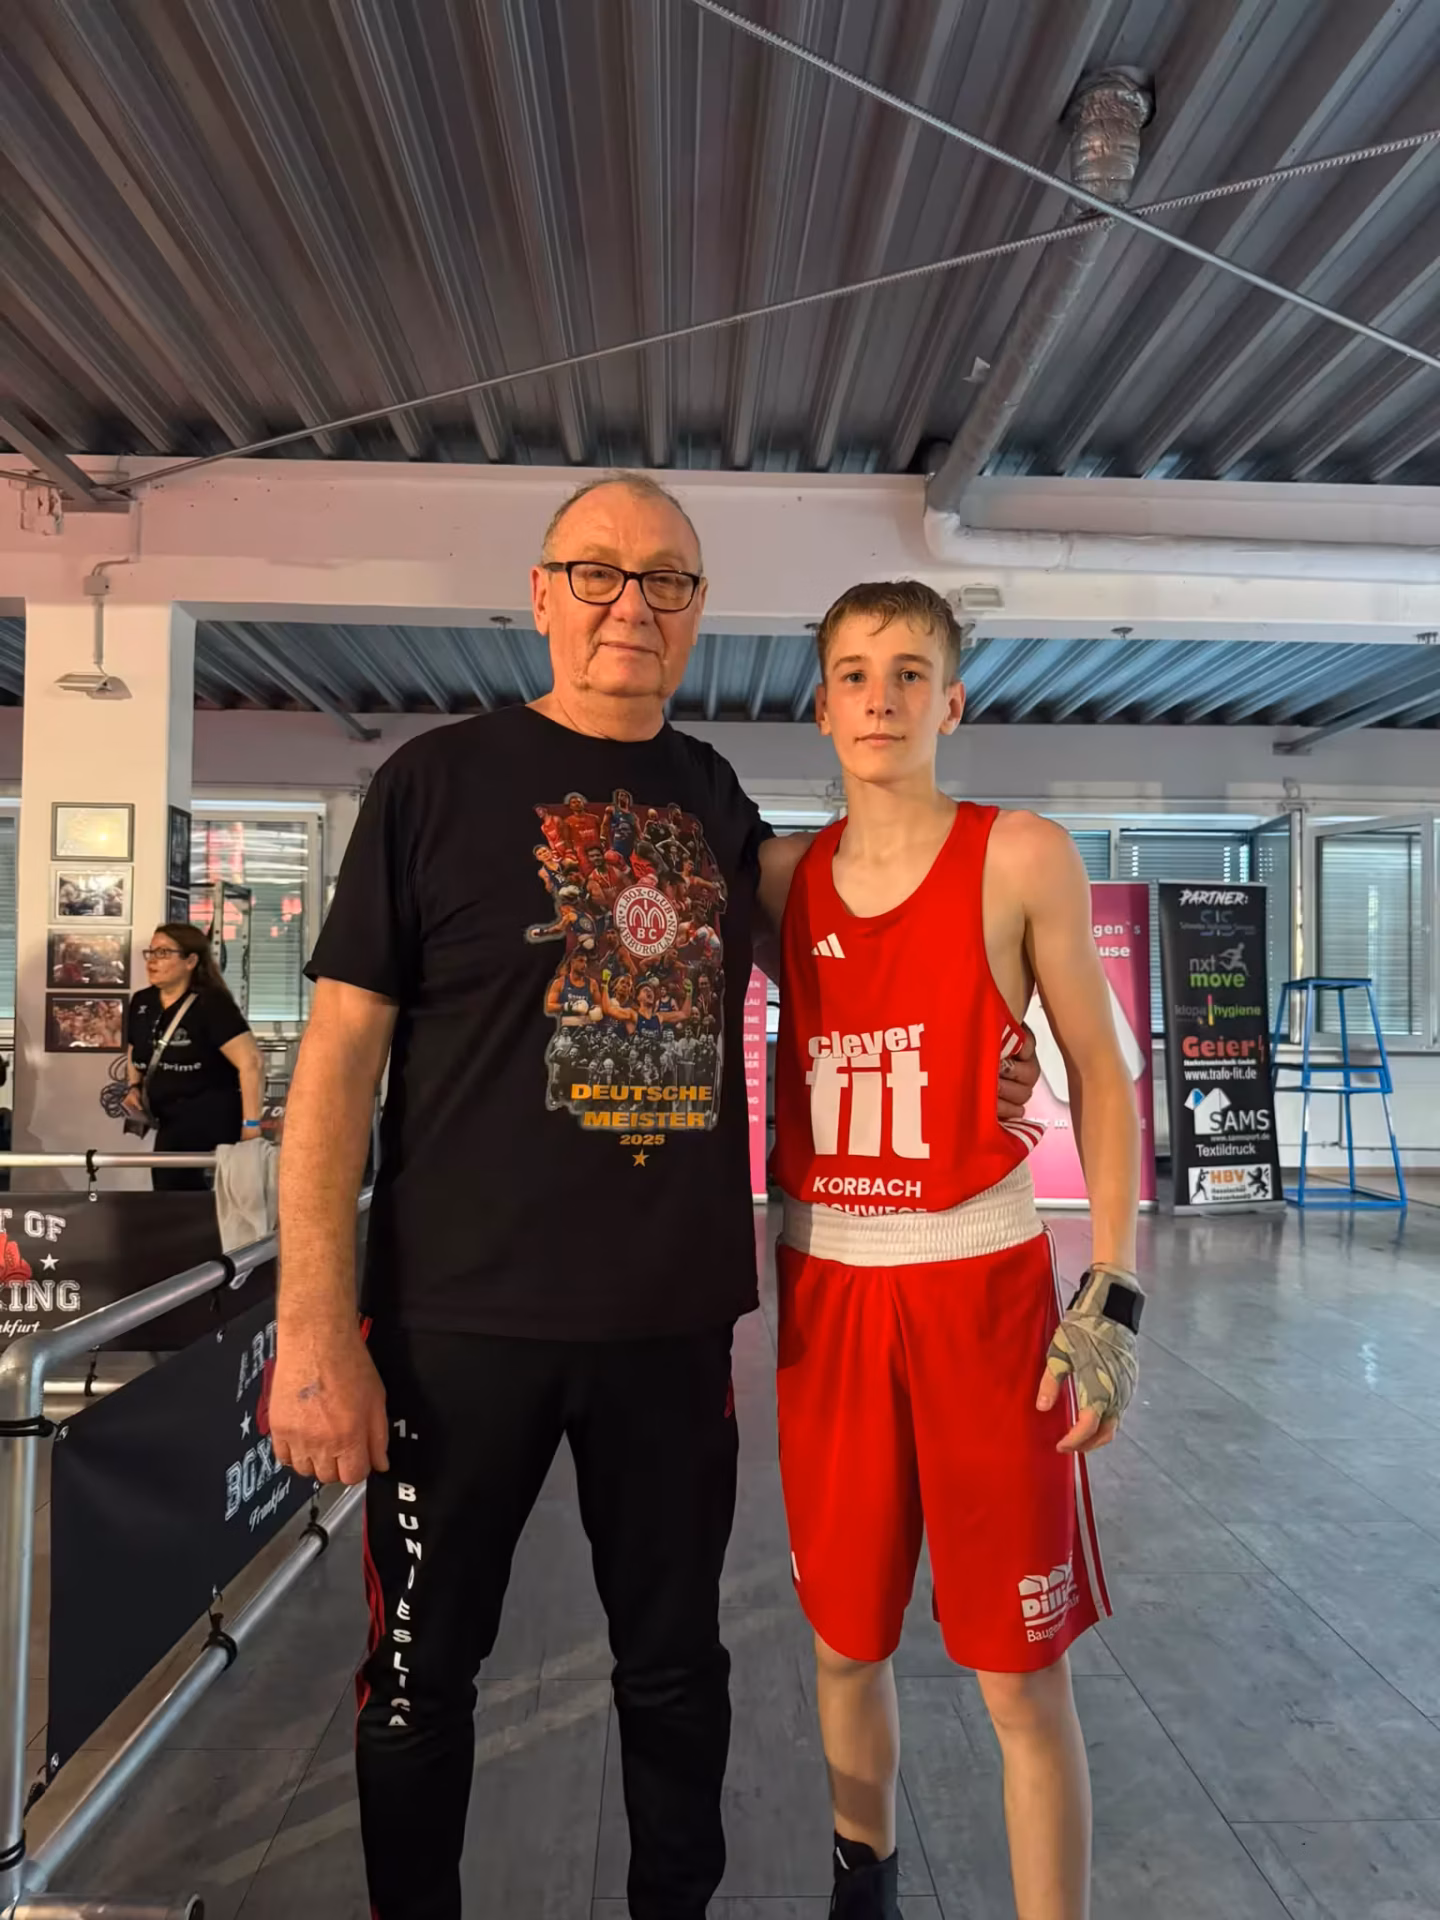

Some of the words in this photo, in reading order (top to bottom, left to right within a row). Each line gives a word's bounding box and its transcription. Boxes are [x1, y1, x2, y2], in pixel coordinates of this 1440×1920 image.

[1179, 888, 1249, 907] PARTNER:
[1189, 954, 1216, 971] nxt
[1190, 973, 1246, 988] move
[808, 1023, 925, 1059] clever
[1182, 1035, 1255, 1057] Geier
[571, 1084, 713, 1101] DEUTSCHE
[805, 1051, 931, 1160] fit
[583, 1111, 706, 1128] MEISTER
[1209, 1109, 1270, 1131] SAMS
[619, 1134, 666, 1145] 2025
[1196, 1142, 1256, 1157] Textildruck
[1209, 1169, 1246, 1184] HBV
[812, 1176, 922, 1198] KORBACH
[24, 1210, 66, 1242] OF
